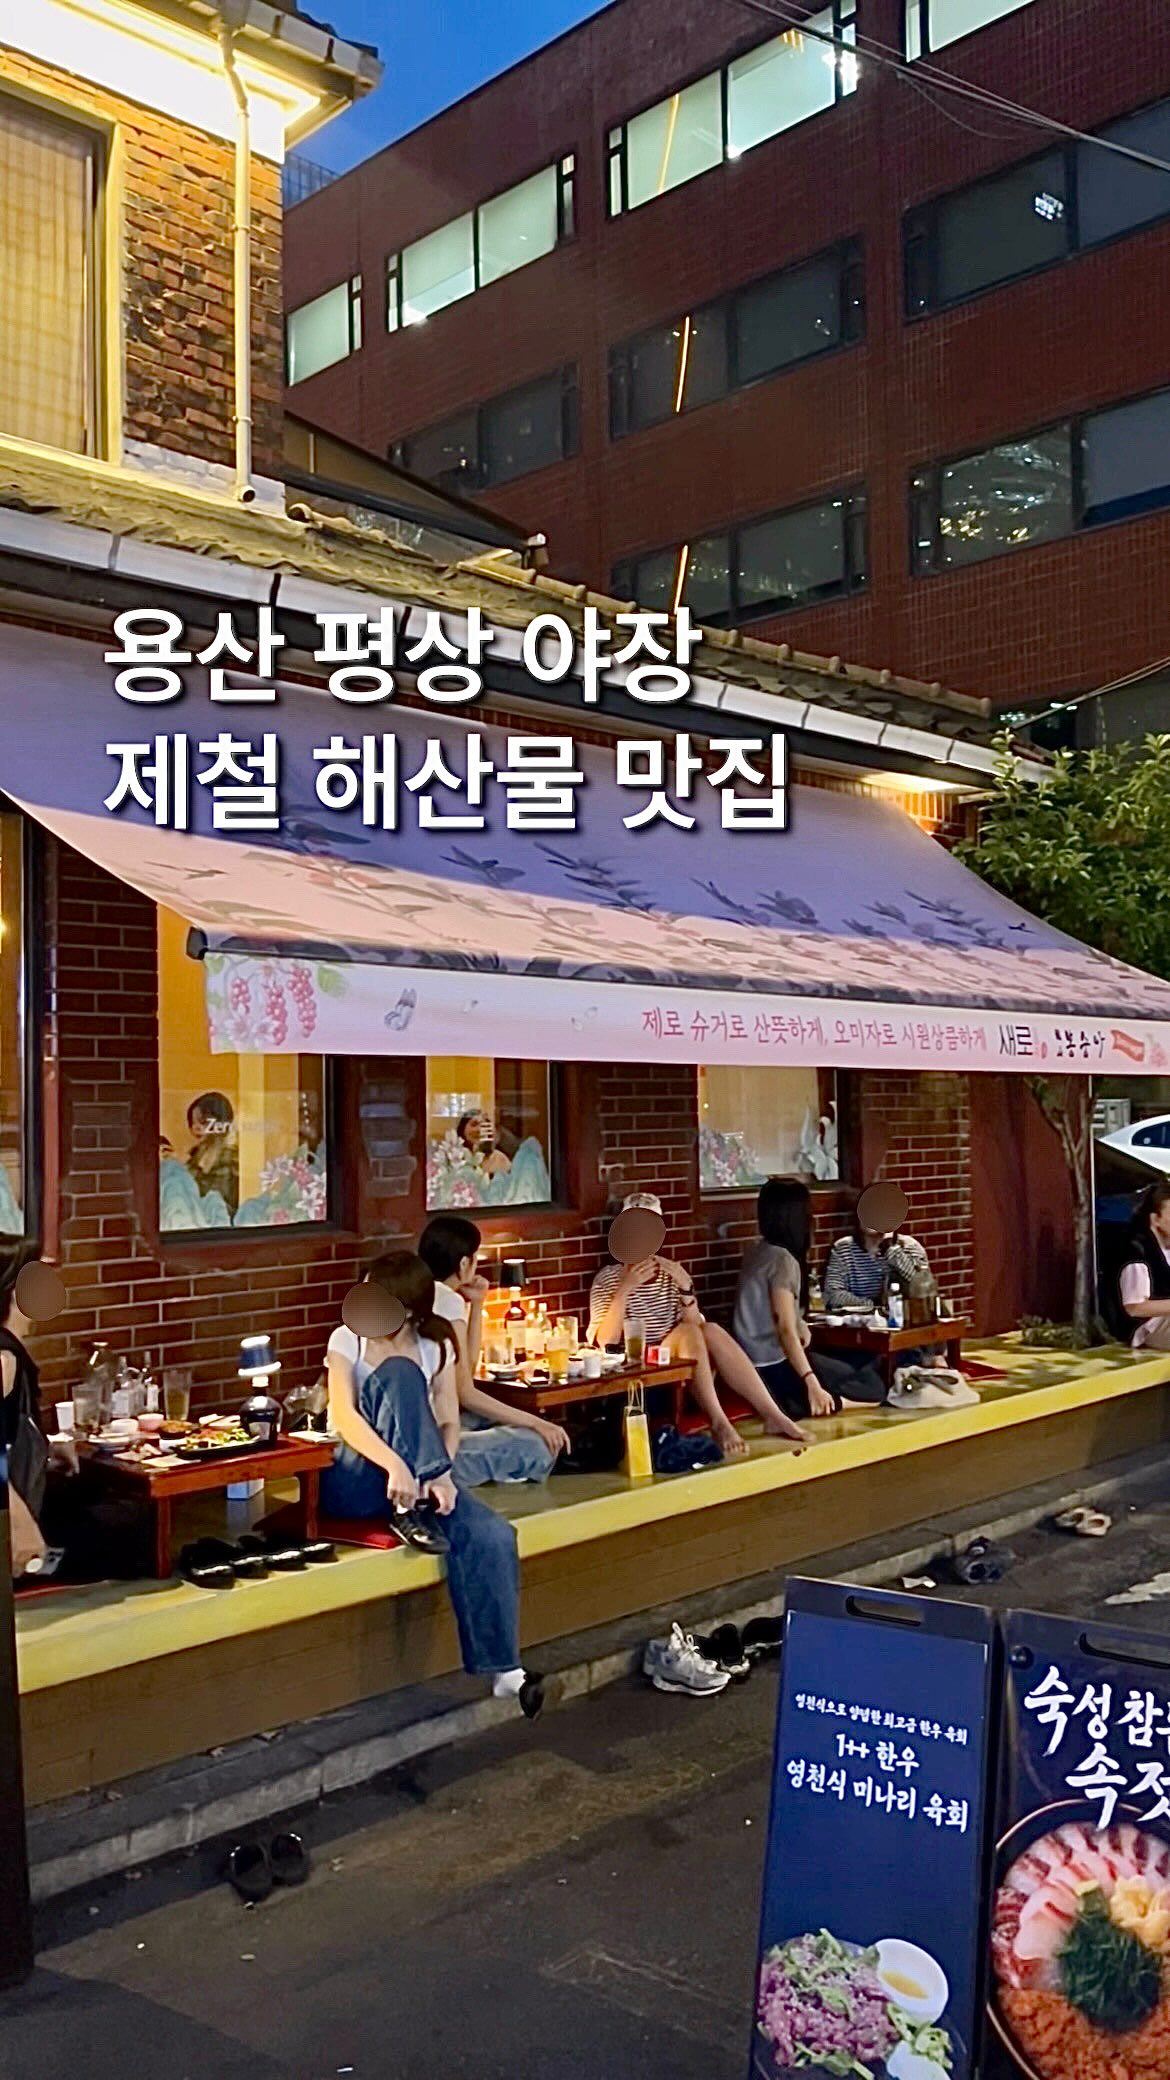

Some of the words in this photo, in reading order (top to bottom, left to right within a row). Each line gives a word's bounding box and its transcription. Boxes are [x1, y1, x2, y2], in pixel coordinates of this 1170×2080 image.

[642, 1006, 684, 1040] 제로
[690, 1010, 748, 1043] 슈거로
[754, 1013, 829, 1047] 산뜻하게,
[834, 1018, 898, 1048] 오미자로
[999, 1024, 1033, 1056] 새로
[795, 1693, 847, 1717] 영천식으로
[849, 1705, 882, 1726] 양념한
[883, 1712, 917, 1734] 최고급
[919, 1720, 942, 1740] 한우
[944, 1726, 968, 1745] 육회
[1024, 1665, 1113, 1758] 숙성
[1113, 1690, 1170, 1755] 참
[836, 1733, 870, 1759] 1++
[875, 1740, 920, 1778] 한우
[786, 1758, 847, 1801] 영천식
[853, 1776, 916, 1819] 미나리
[922, 1792, 968, 1833] 육회
